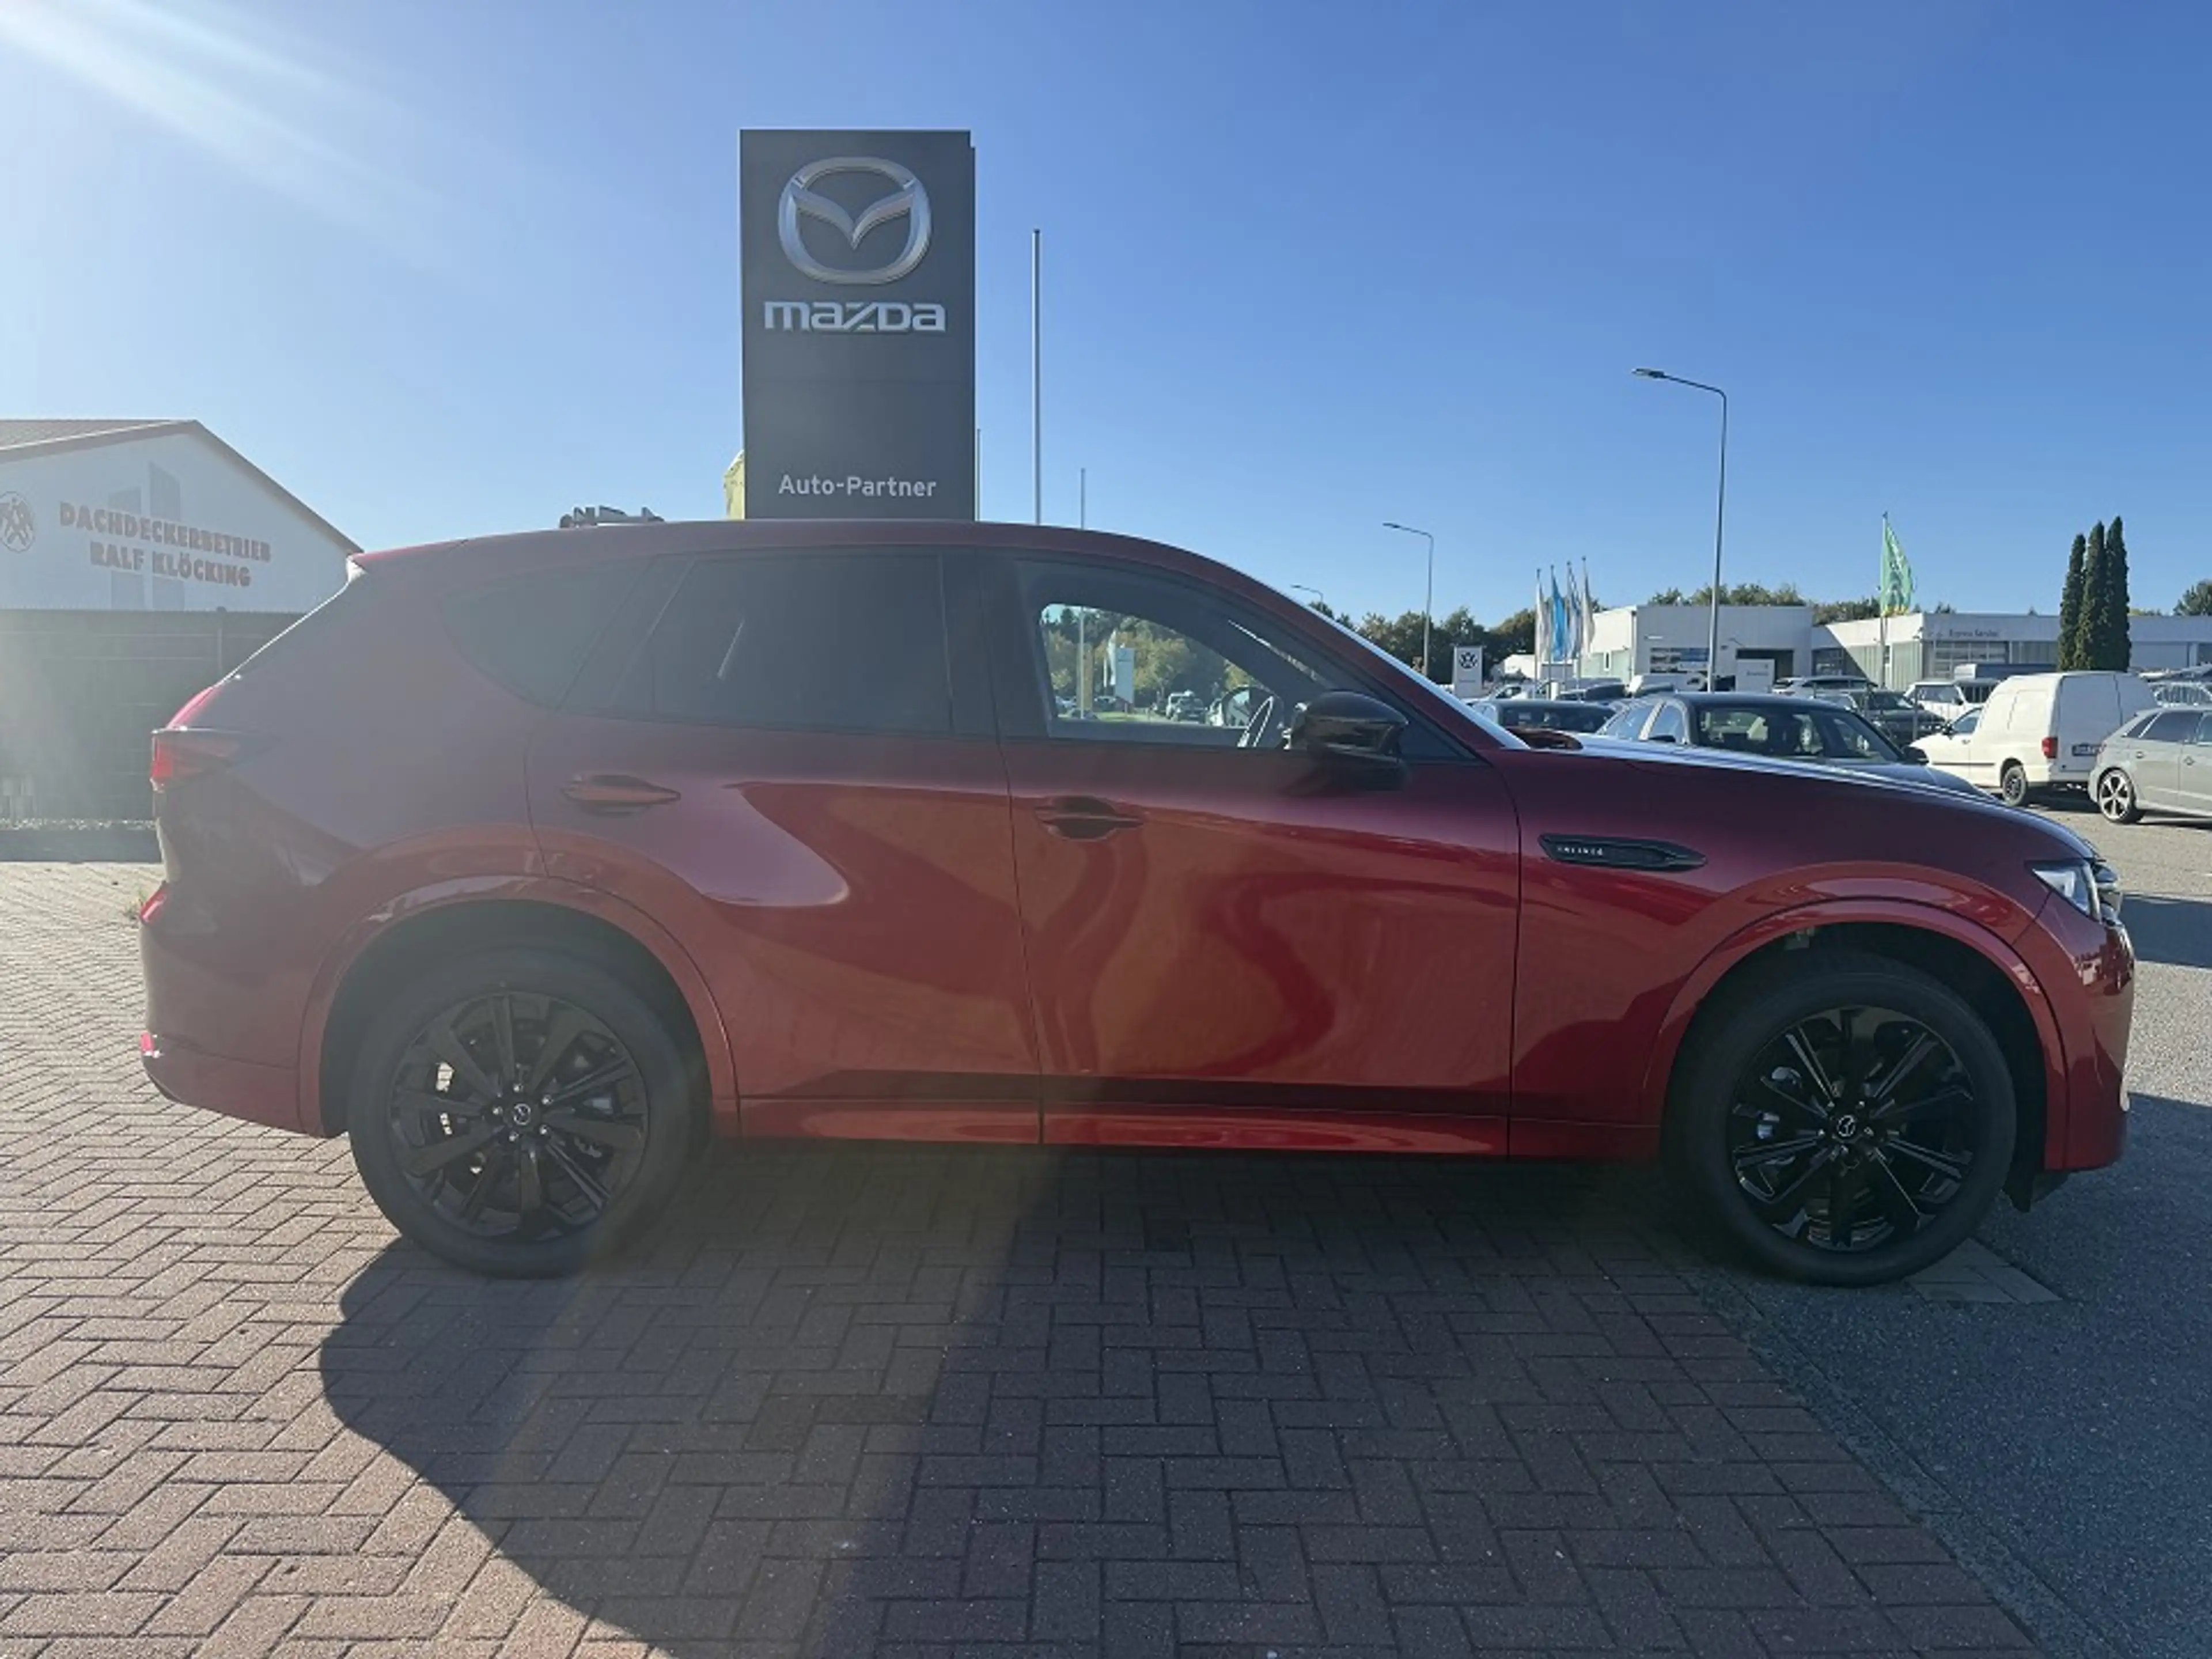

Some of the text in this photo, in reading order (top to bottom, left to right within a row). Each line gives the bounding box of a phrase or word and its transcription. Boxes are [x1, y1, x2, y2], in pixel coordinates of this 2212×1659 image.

[764, 301, 946, 332] mazda
[778, 474, 937, 497] Auto-Partner
[60, 501, 271, 562] DACHDECKERBETRIEB
[90, 540, 252, 587] RALF KLÖCKING
